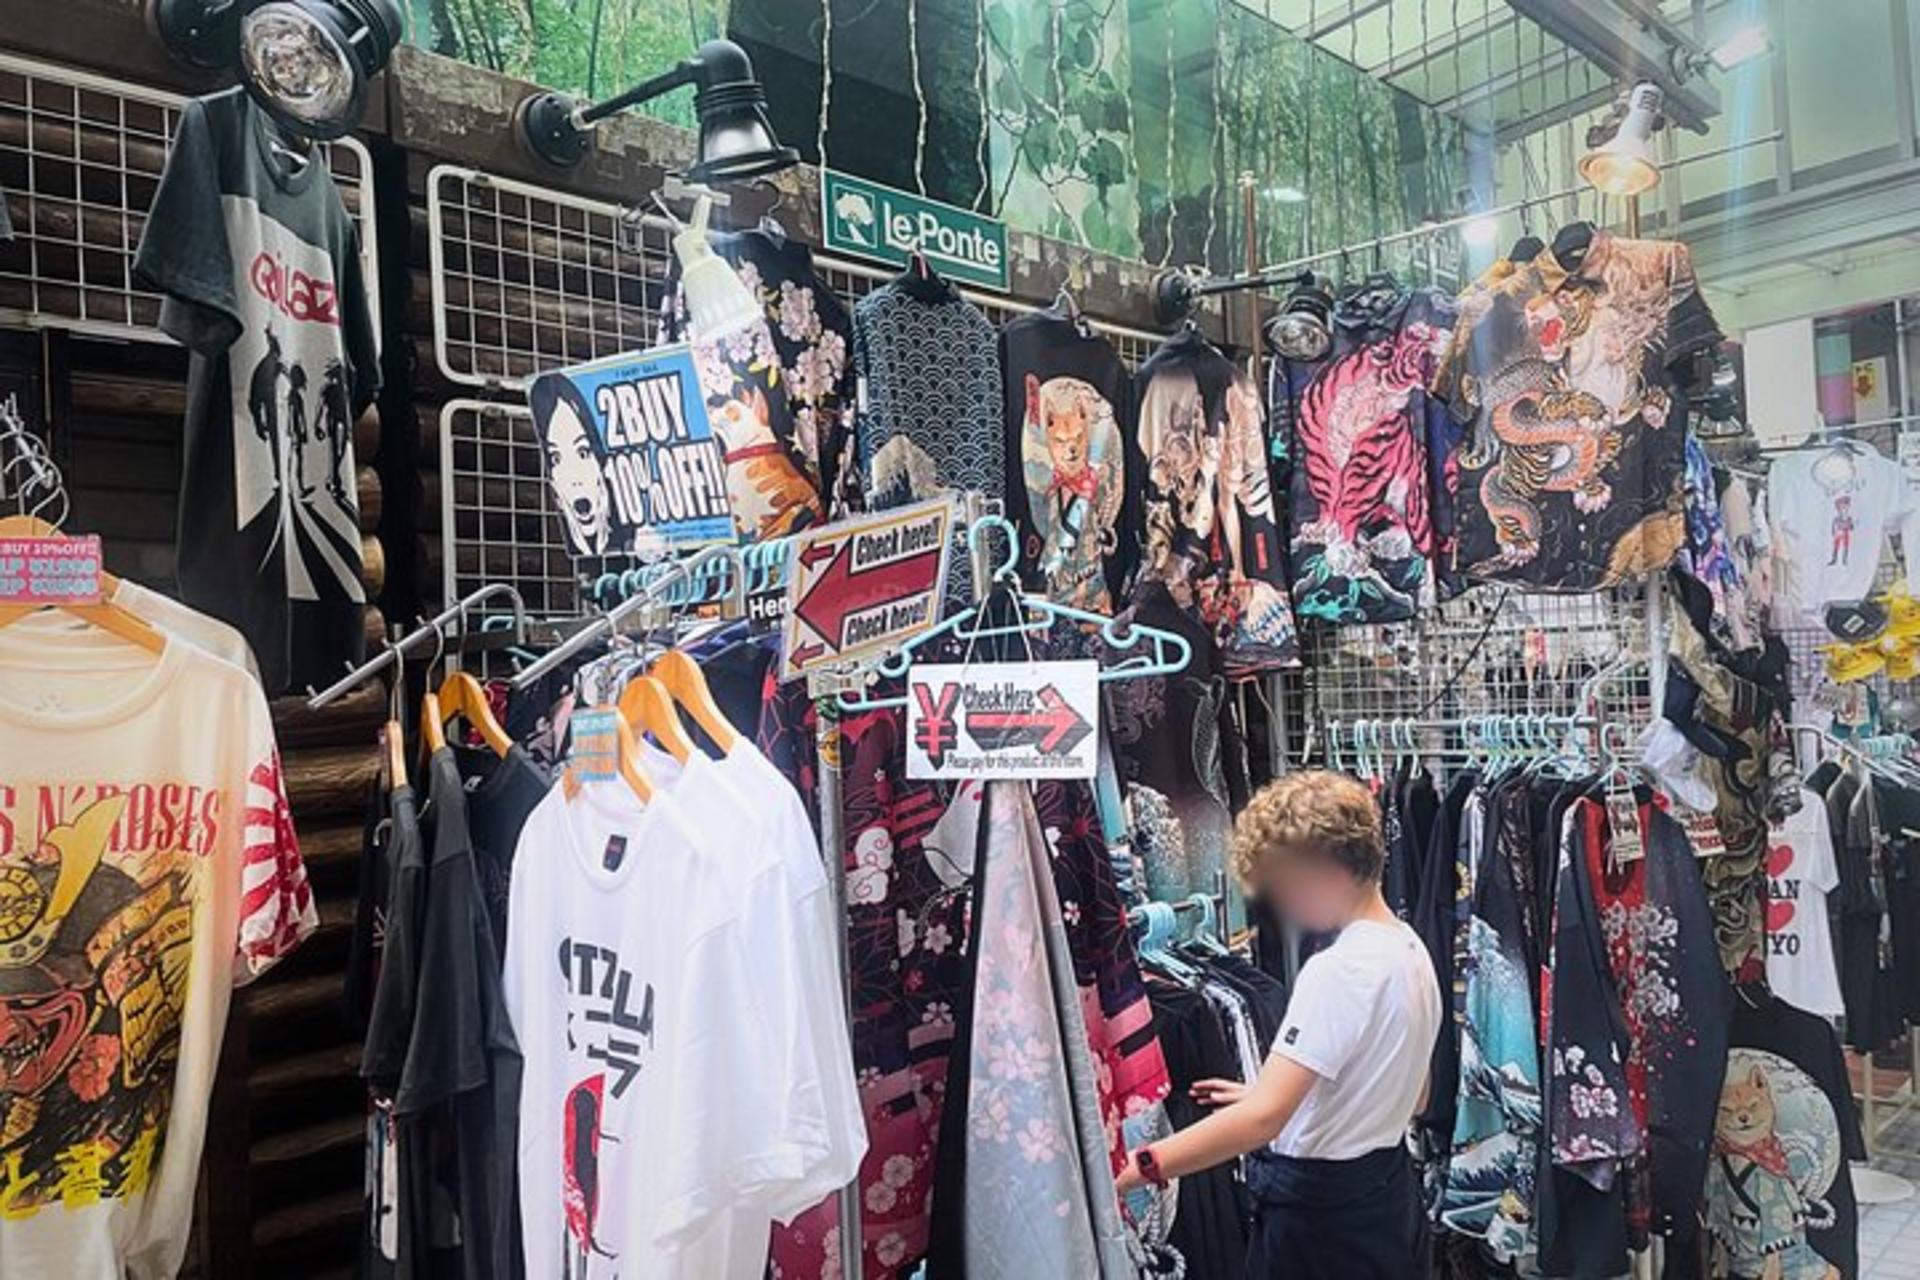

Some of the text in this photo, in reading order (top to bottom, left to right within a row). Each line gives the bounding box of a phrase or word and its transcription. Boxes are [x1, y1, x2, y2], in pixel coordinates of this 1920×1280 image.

[595, 371, 691, 452] 2BUY
[603, 439, 732, 527] 10%OFF!!
[856, 527, 899, 566] Check
[846, 606, 888, 646] Check
[963, 682, 1003, 710] Check
